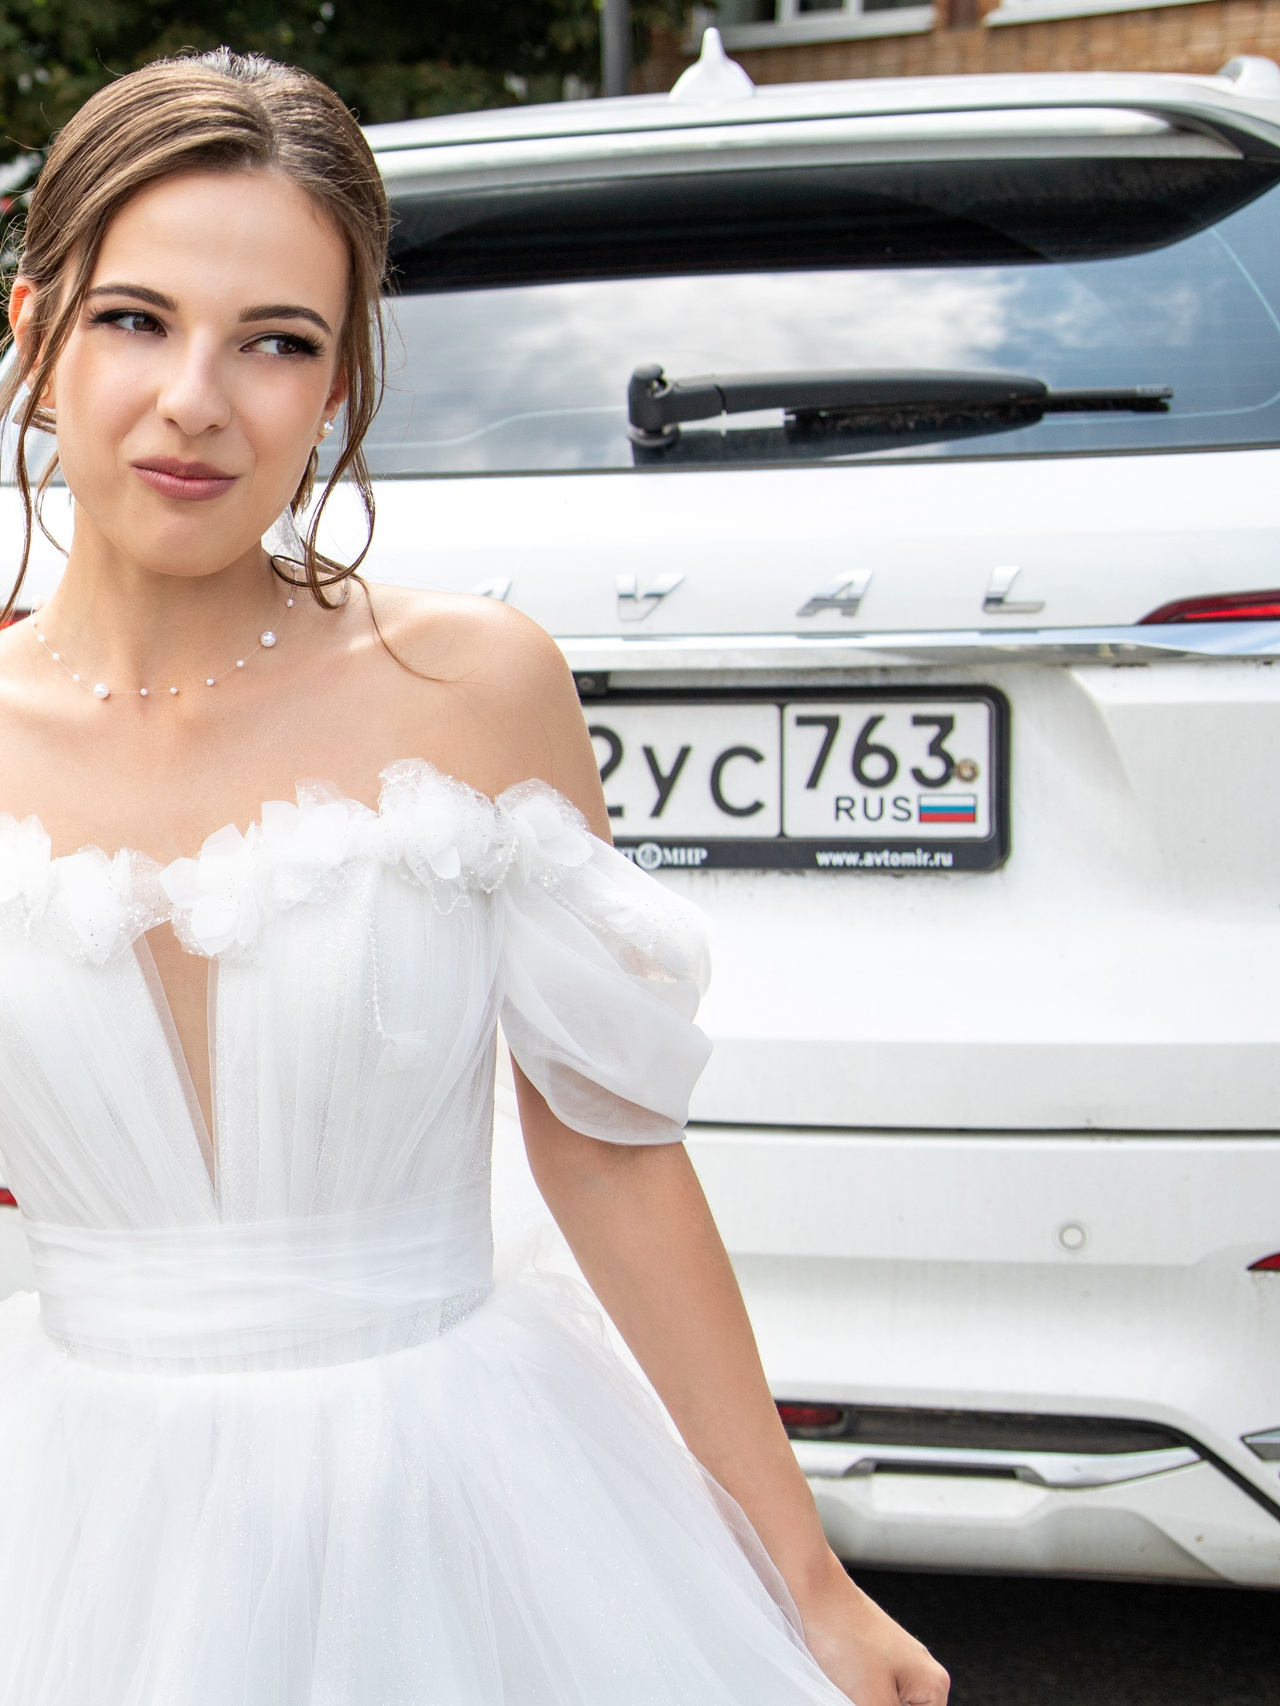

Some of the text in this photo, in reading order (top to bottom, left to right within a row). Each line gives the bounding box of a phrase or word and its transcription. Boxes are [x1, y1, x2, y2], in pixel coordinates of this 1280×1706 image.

[796, 714, 956, 789] 763
[835, 796, 912, 822] RUS
[815, 848, 953, 867] www.avtomir.ru
